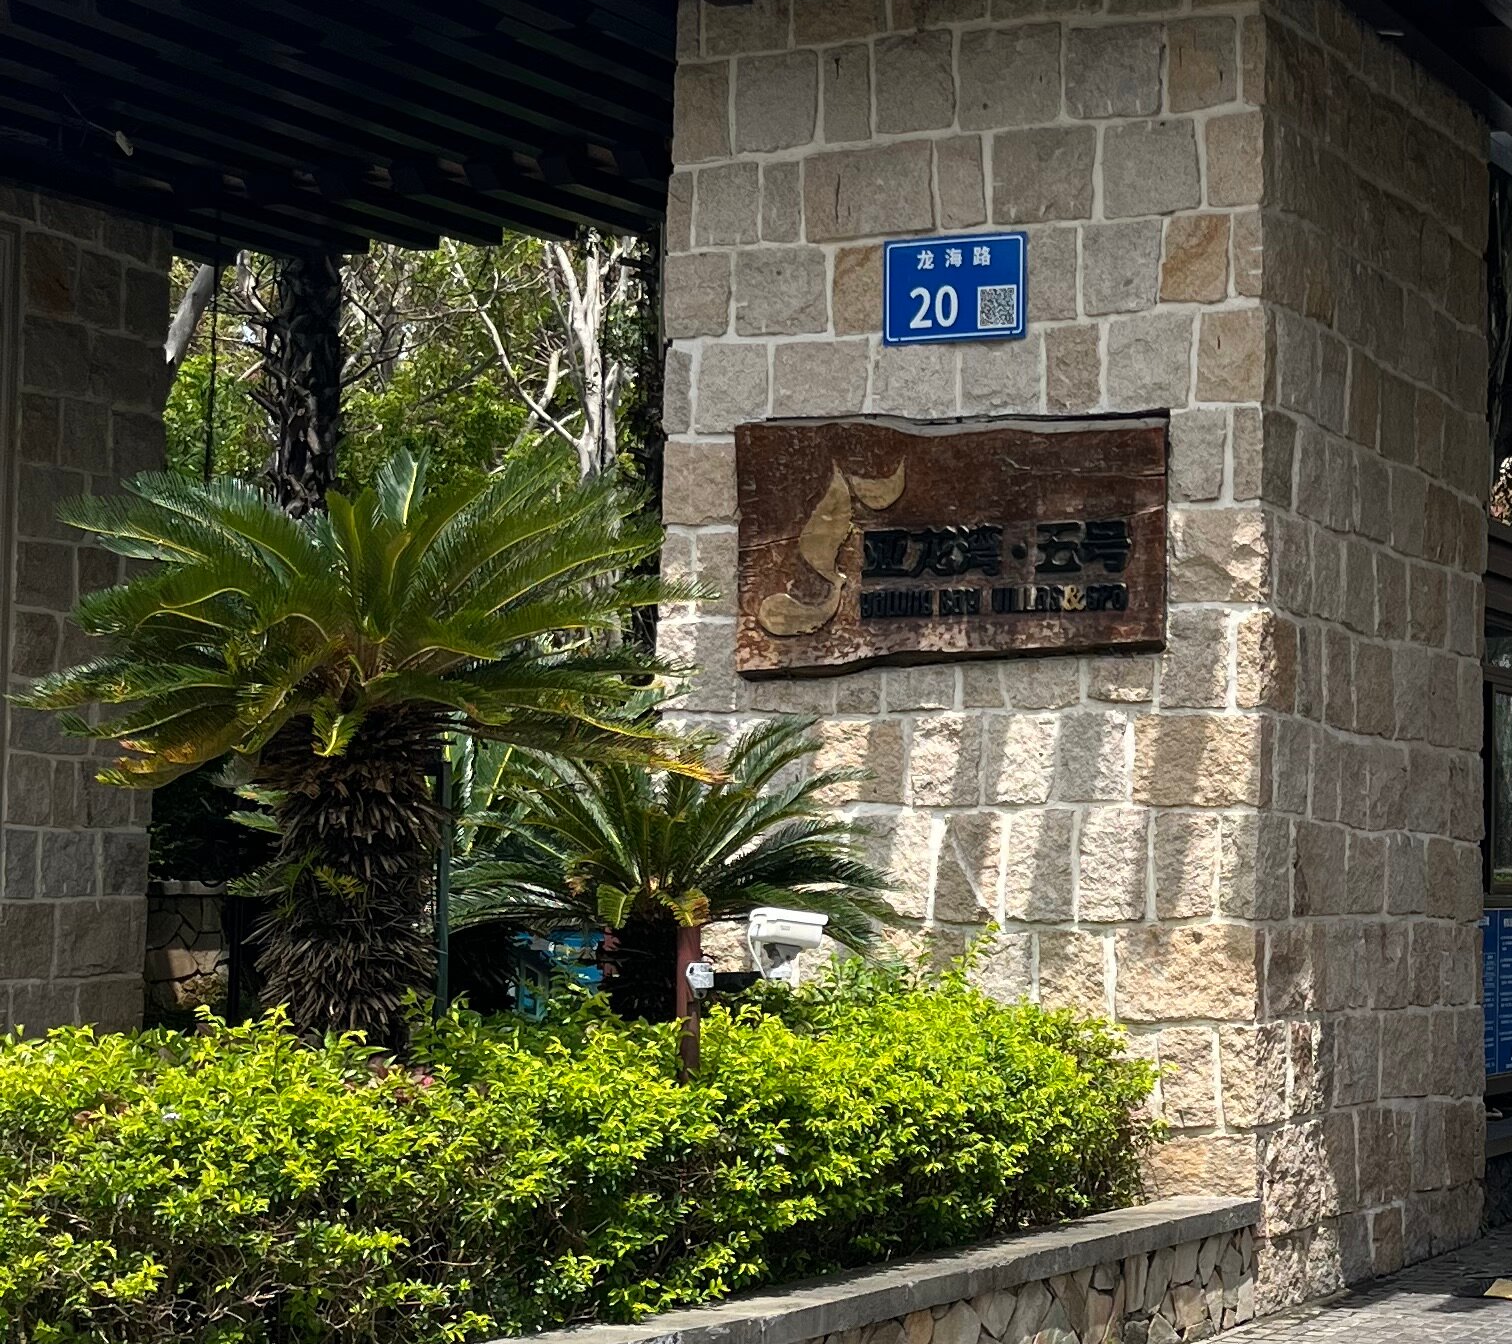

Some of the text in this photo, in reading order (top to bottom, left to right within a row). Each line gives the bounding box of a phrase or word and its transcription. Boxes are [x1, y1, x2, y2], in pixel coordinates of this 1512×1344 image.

[917, 246, 991, 270] 龙海路
[909, 285, 959, 329] 20
